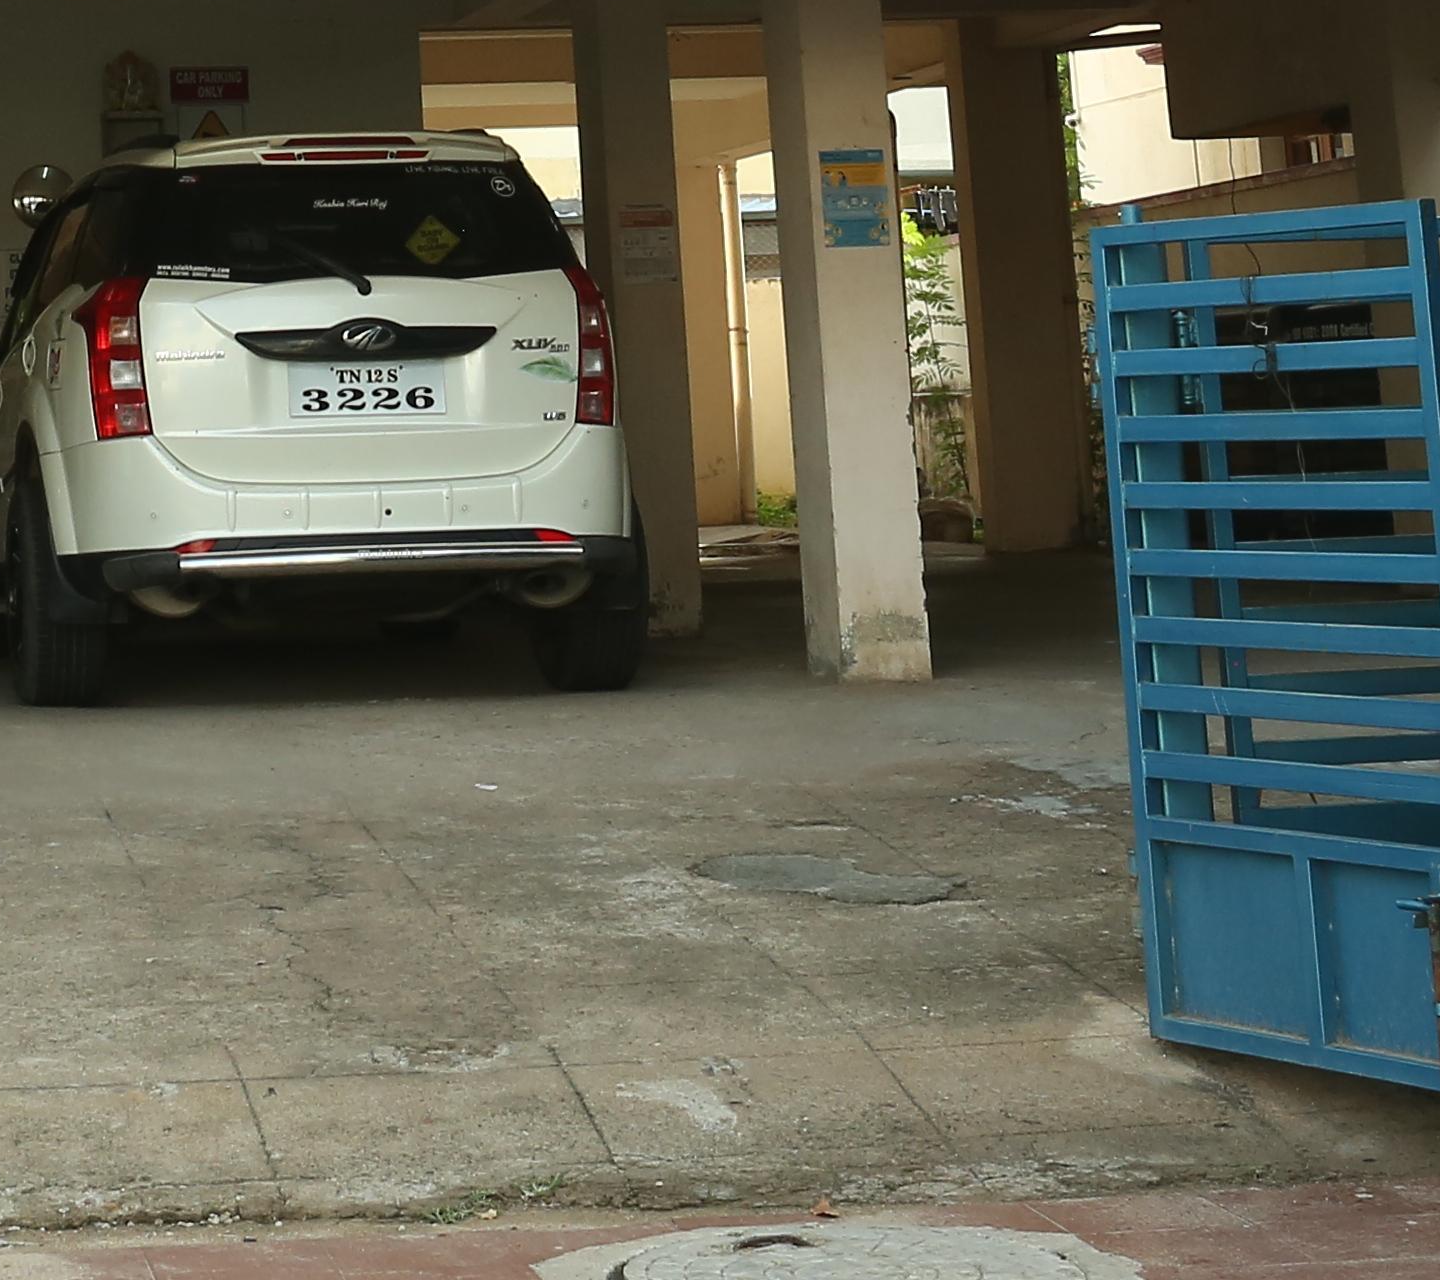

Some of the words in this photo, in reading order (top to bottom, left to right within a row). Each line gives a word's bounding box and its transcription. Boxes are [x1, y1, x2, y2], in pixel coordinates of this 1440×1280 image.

[336, 369, 363, 384] TN
[365, 369, 385, 383] 12
[387, 369, 398, 383] S
[302, 387, 435, 412] 3226
